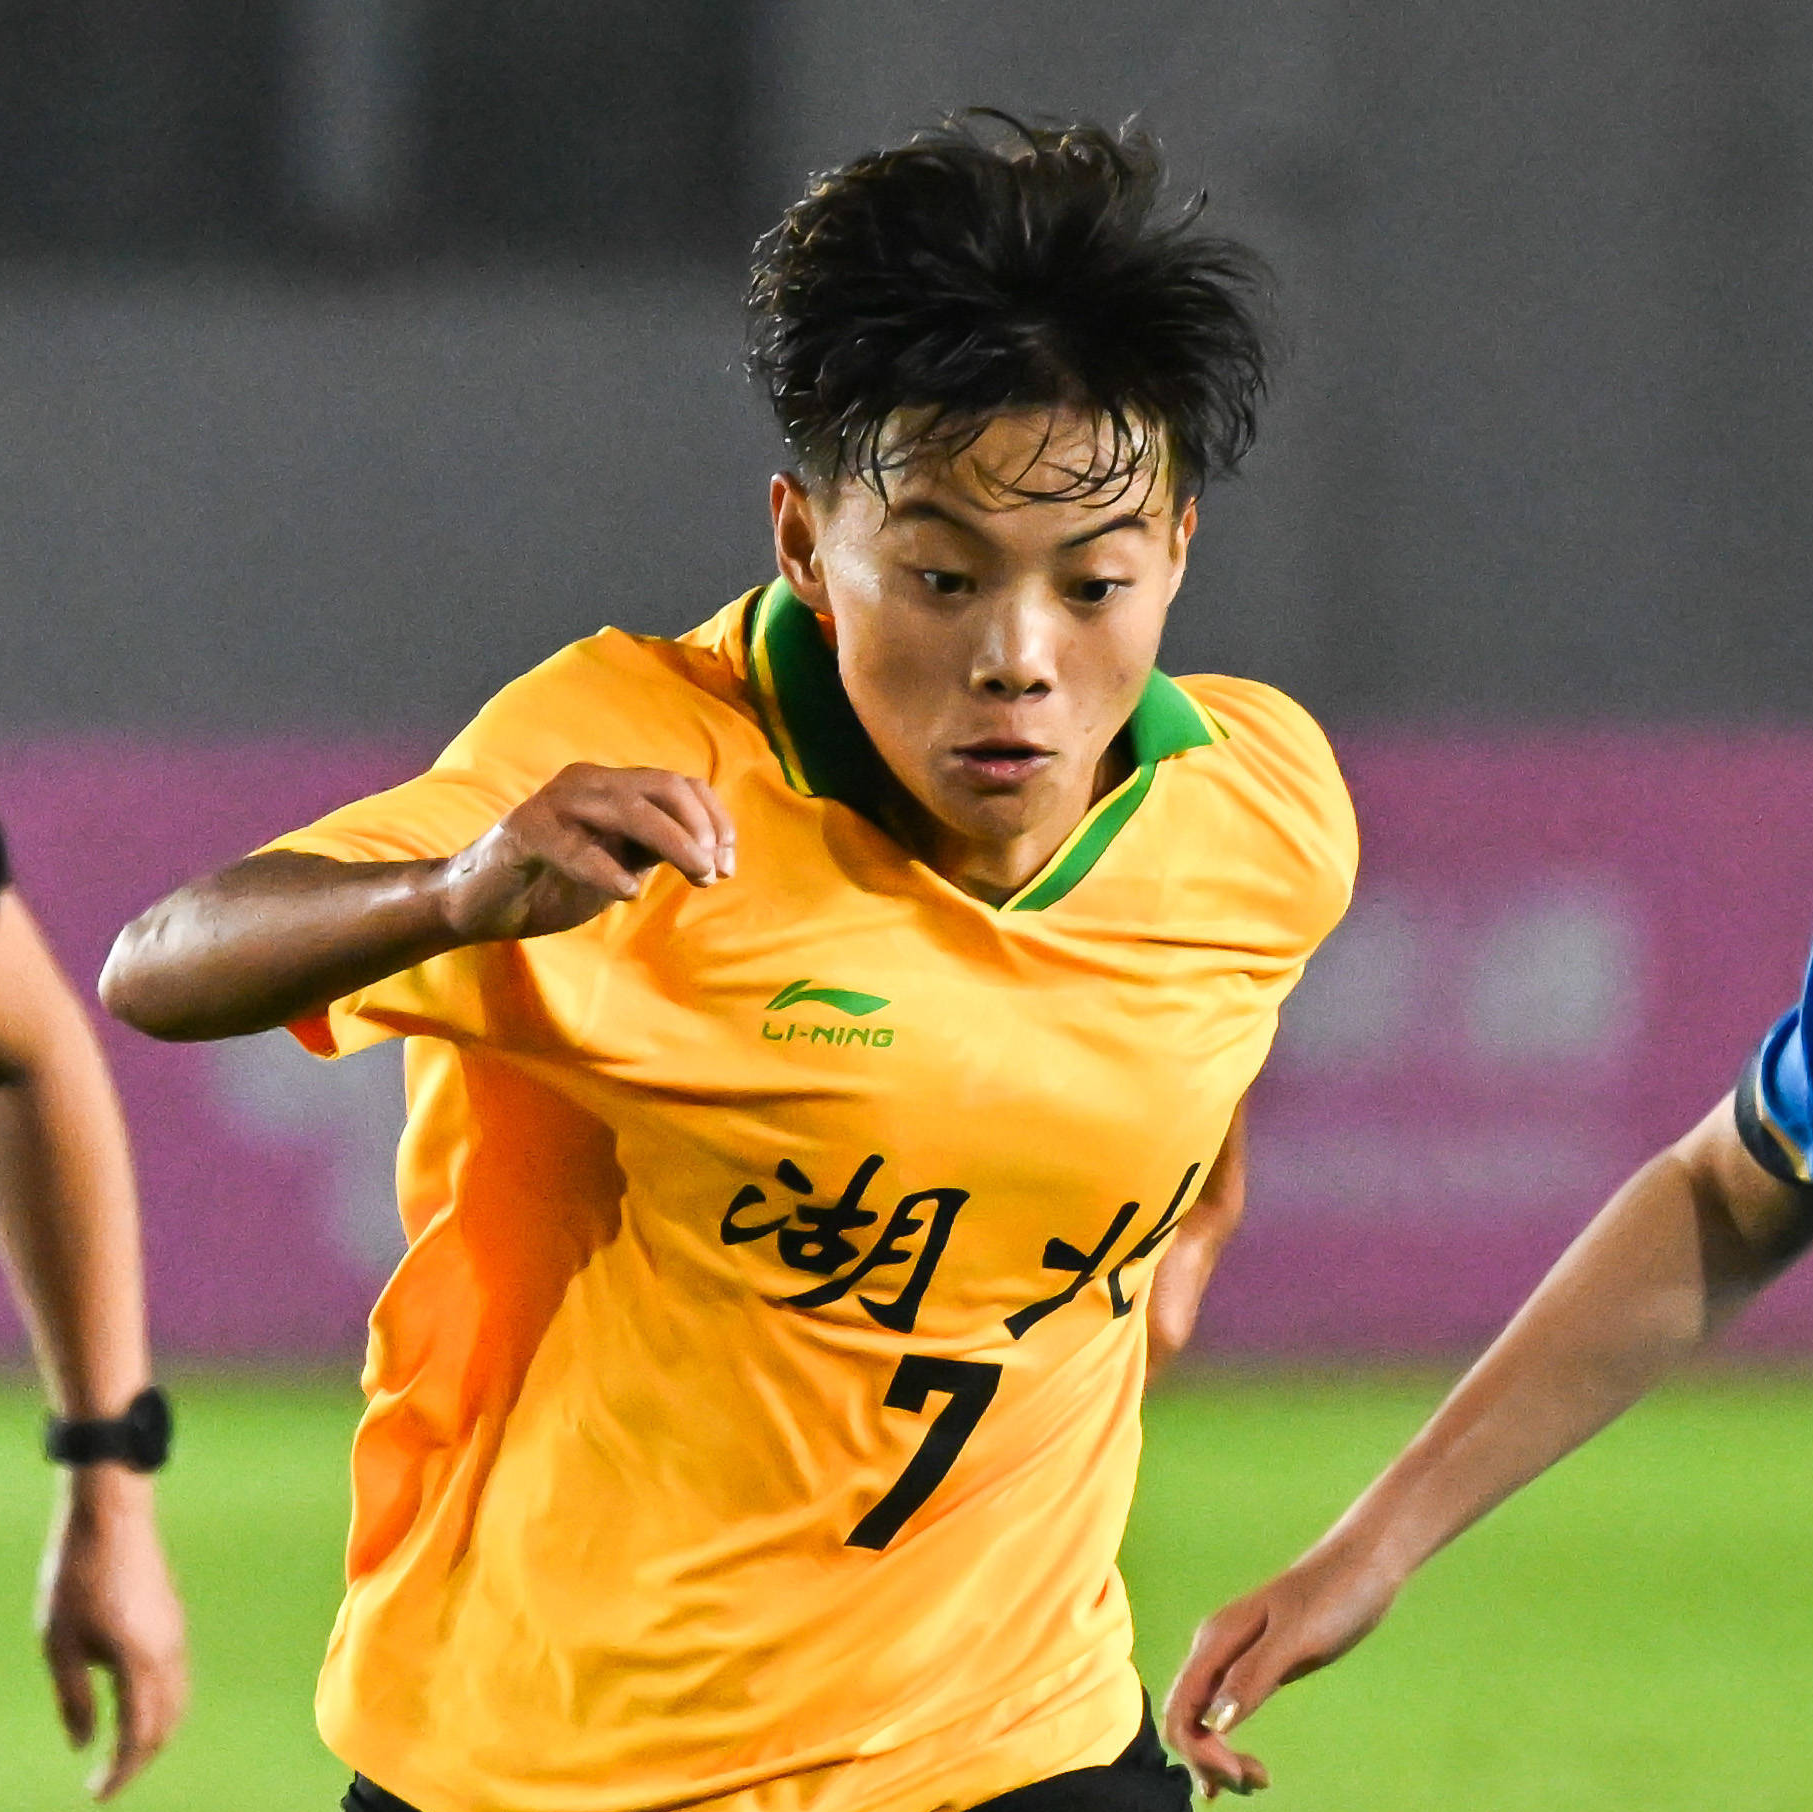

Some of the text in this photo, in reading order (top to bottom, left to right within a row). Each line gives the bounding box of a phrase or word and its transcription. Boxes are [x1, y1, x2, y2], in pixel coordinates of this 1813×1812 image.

[762, 1021, 895, 1048] LI-NING
[720, 1153, 1202, 1342] 湖北
[844, 1353, 1004, 1552] 7
